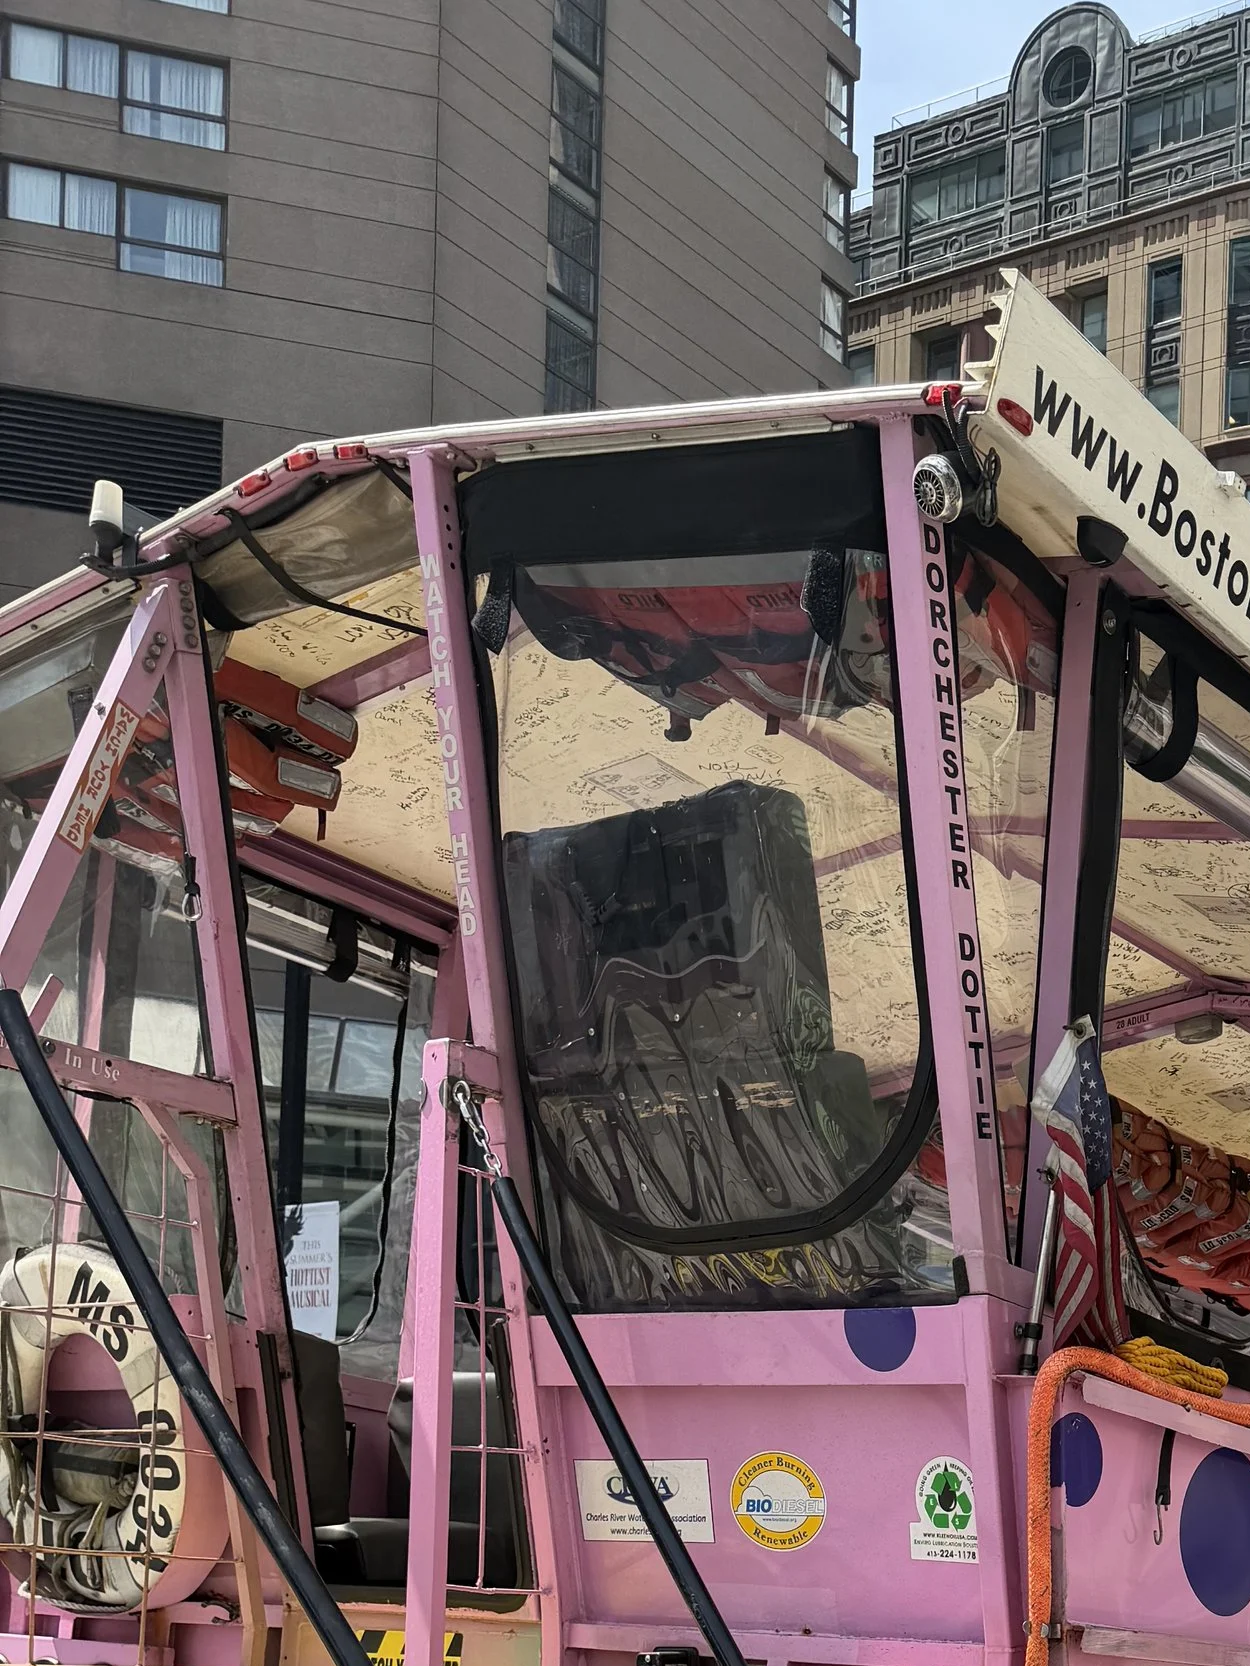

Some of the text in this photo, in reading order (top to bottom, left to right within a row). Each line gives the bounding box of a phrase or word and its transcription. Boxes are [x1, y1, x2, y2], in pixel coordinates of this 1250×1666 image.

[420, 554, 477, 936] WATCH YOUR HEAD
[66, 707, 134, 842] WATCH YOUR HEAD
[923, 523, 992, 1139] DORCHESTER DOTTIE
[1127, 1013, 1150, 1027] ADULT
[65, 1048, 120, 1081] In Use
[1180, 1186, 1194, 1203] MS
[302, 1240, 321, 1250] THIS
[290, 1267, 331, 1287] HOTTEST
[290, 1289, 331, 1308] MUSICAL
[67, 1261, 135, 1362] MS
[738, 1457, 816, 1491] Cleaner Burning
[746, 1499, 824, 1513] BIODIESEL
[586, 1513, 608, 1522] Charles
[610, 1513, 626, 1521] River
[670, 1514, 706, 1522] ssociation
[753, 1527, 808, 1546] Renewable
[927, 1550, 976, 1559] 413-224-1178
